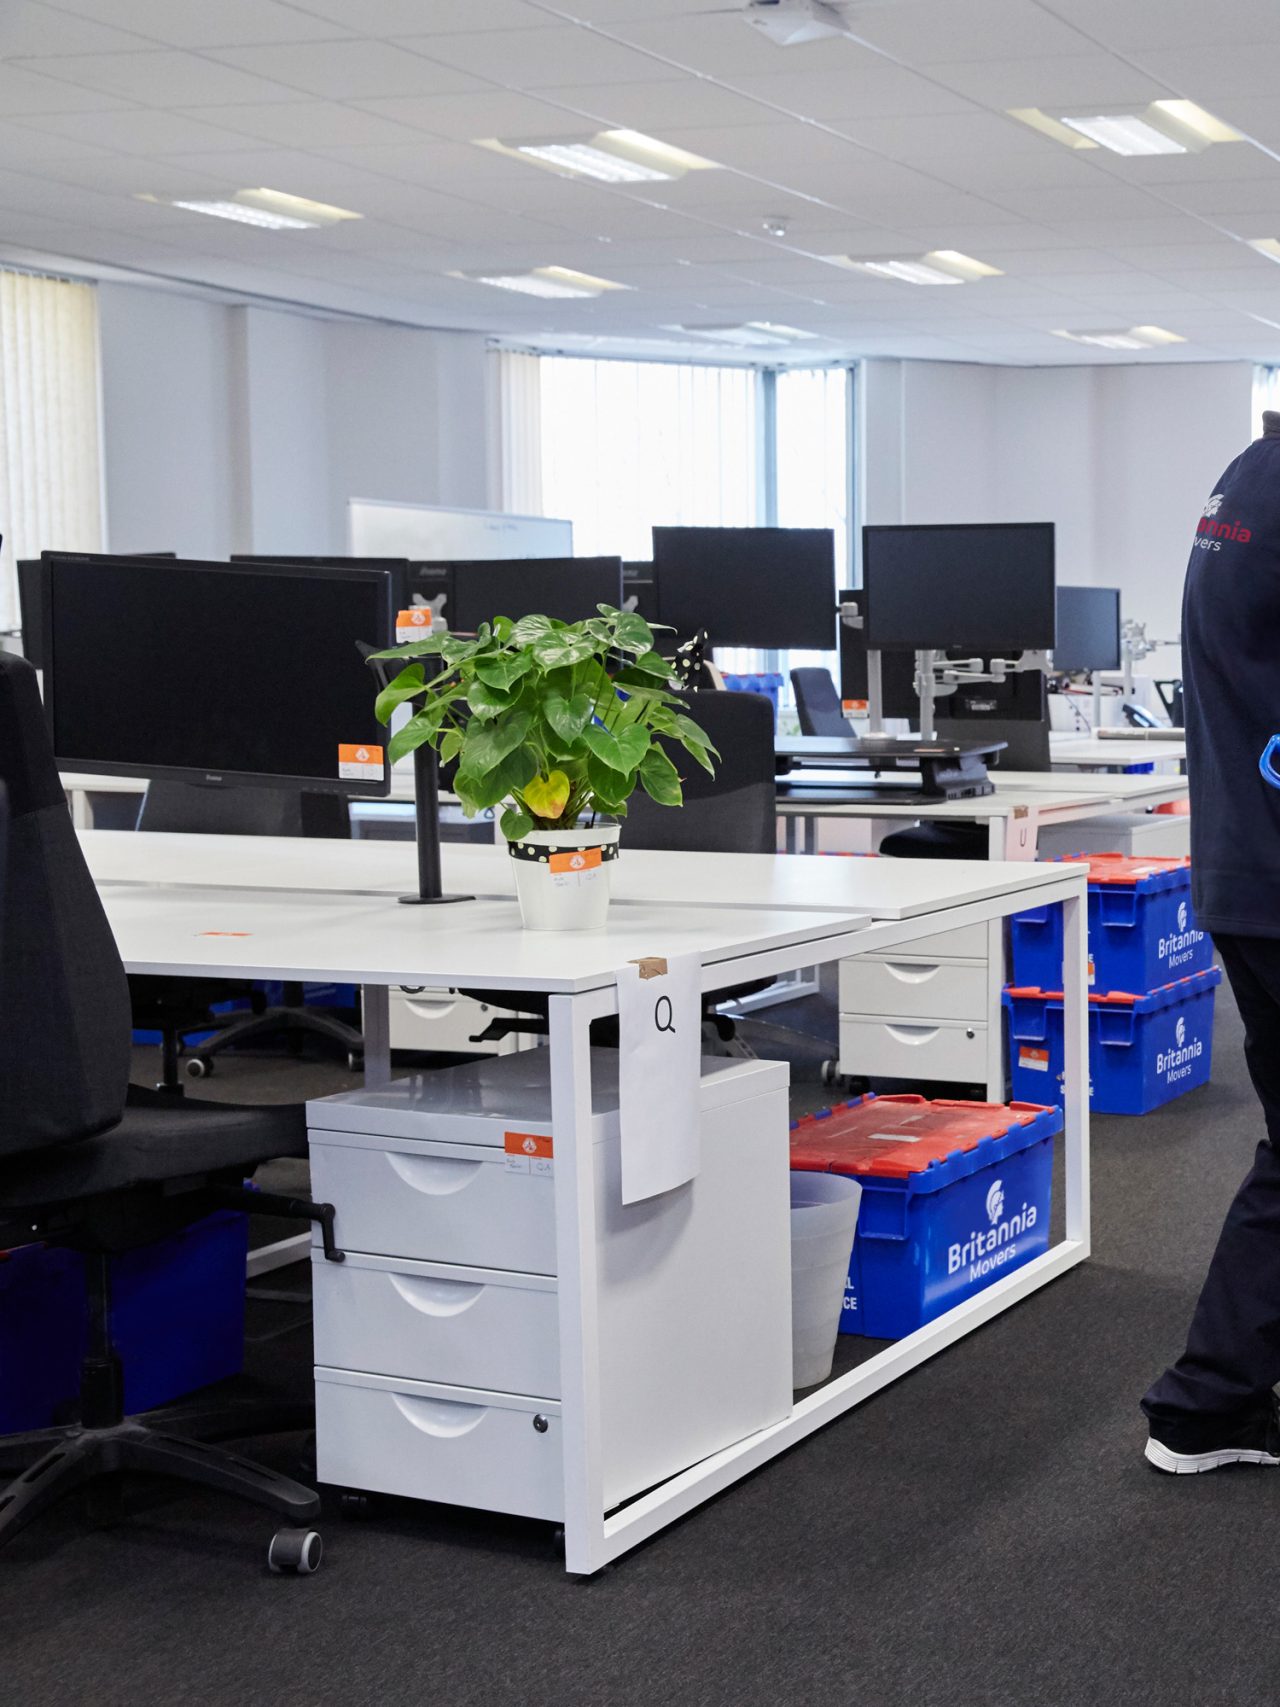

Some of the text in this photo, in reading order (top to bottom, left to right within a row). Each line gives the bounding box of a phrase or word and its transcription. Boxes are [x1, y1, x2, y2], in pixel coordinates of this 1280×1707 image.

[1194, 536, 1222, 551] vers
[1197, 516, 1252, 543] annia
[1168, 949, 1194, 969] Movers
[654, 995, 676, 1034] Q
[1156, 1036, 1202, 1075] Britannia
[1166, 1064, 1192, 1085] Movers
[947, 1202, 1037, 1275] Britannia
[969, 1243, 1017, 1283] Movers
